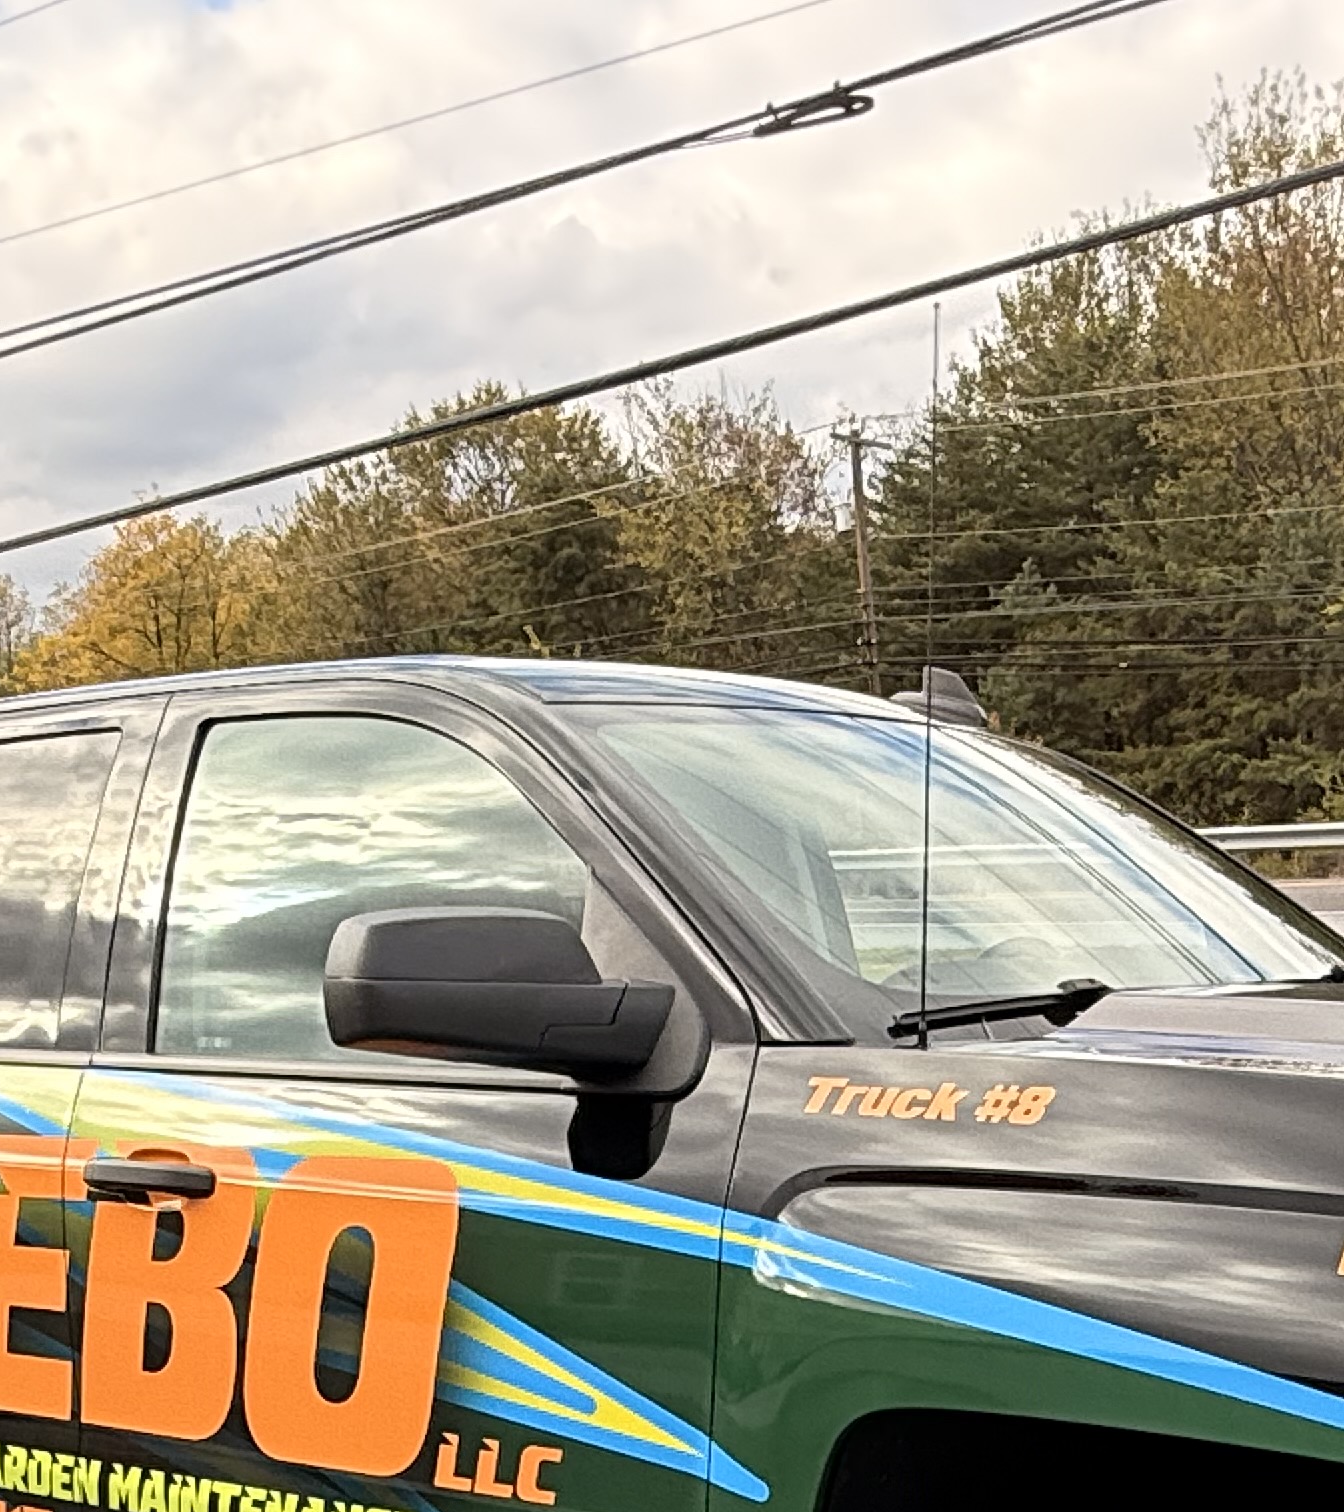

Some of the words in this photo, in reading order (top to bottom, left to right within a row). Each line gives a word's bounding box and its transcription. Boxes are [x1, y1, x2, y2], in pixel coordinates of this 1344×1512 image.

[804, 1075, 965, 1124] Truck
[973, 1083, 1056, 1126] #8
[433, 1433, 563, 1506] LLC
